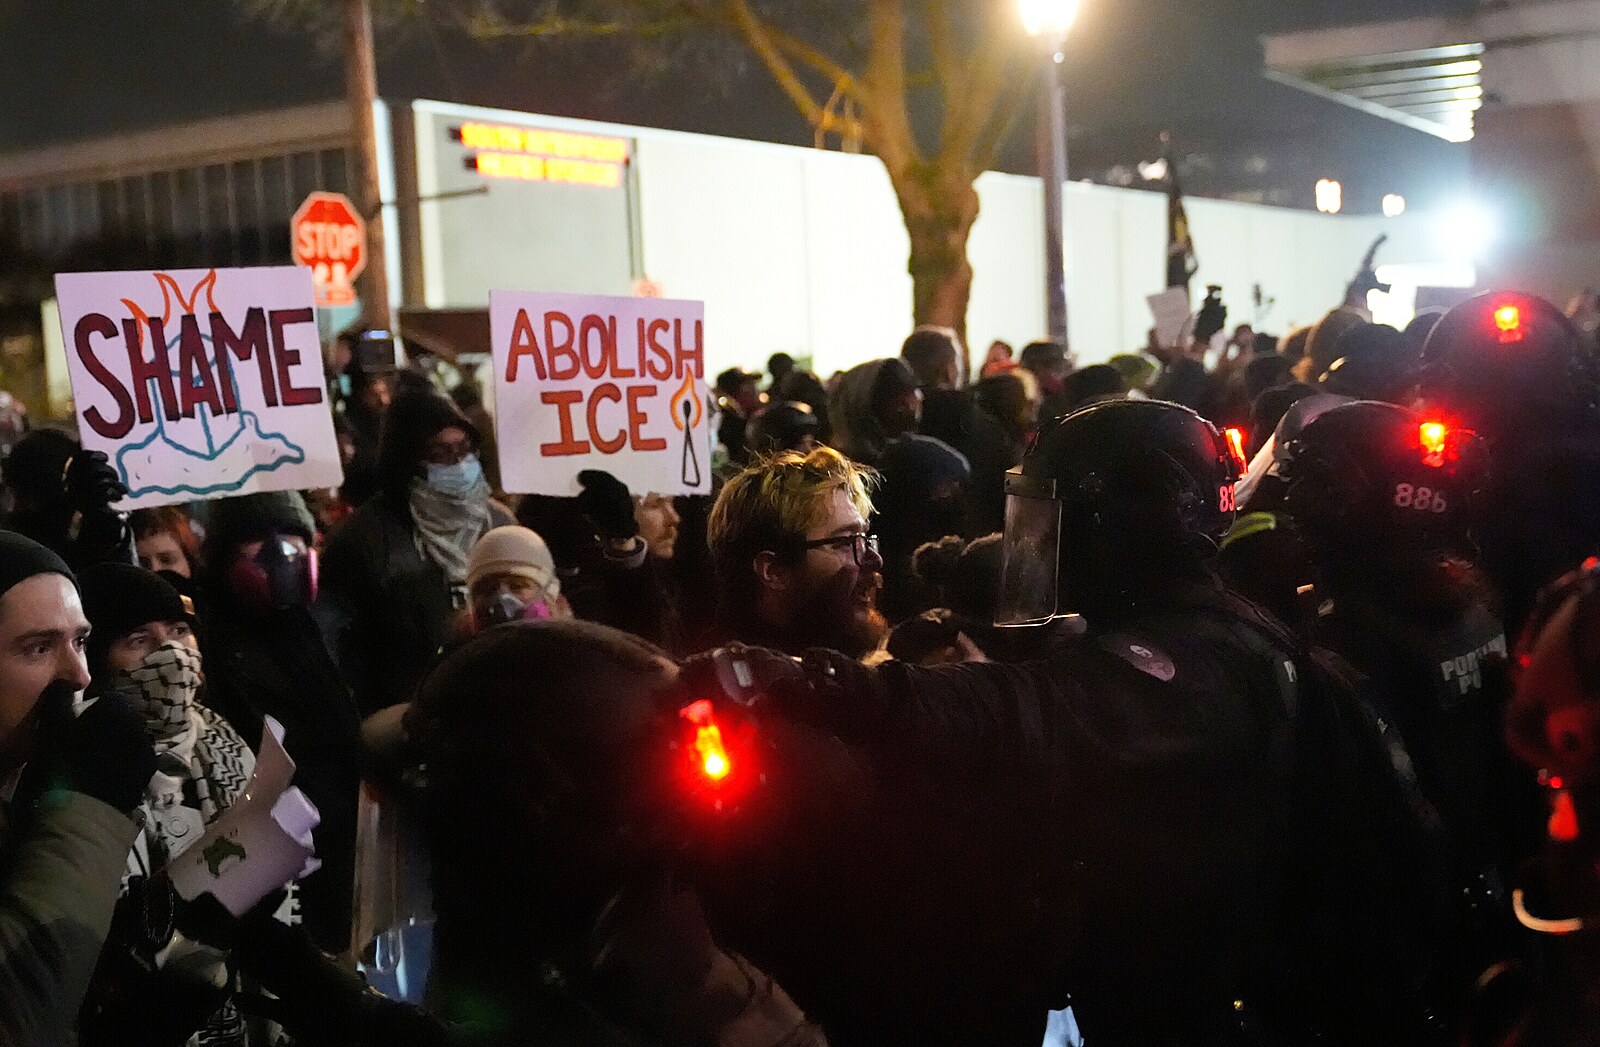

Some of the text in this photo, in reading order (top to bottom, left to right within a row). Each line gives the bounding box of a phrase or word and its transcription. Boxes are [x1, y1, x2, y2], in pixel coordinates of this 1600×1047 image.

[299, 221, 357, 260] STOP
[74, 306, 323, 440] SHAME
[505, 308, 704, 383] ABOLISH
[540, 382, 667, 457] ICE
